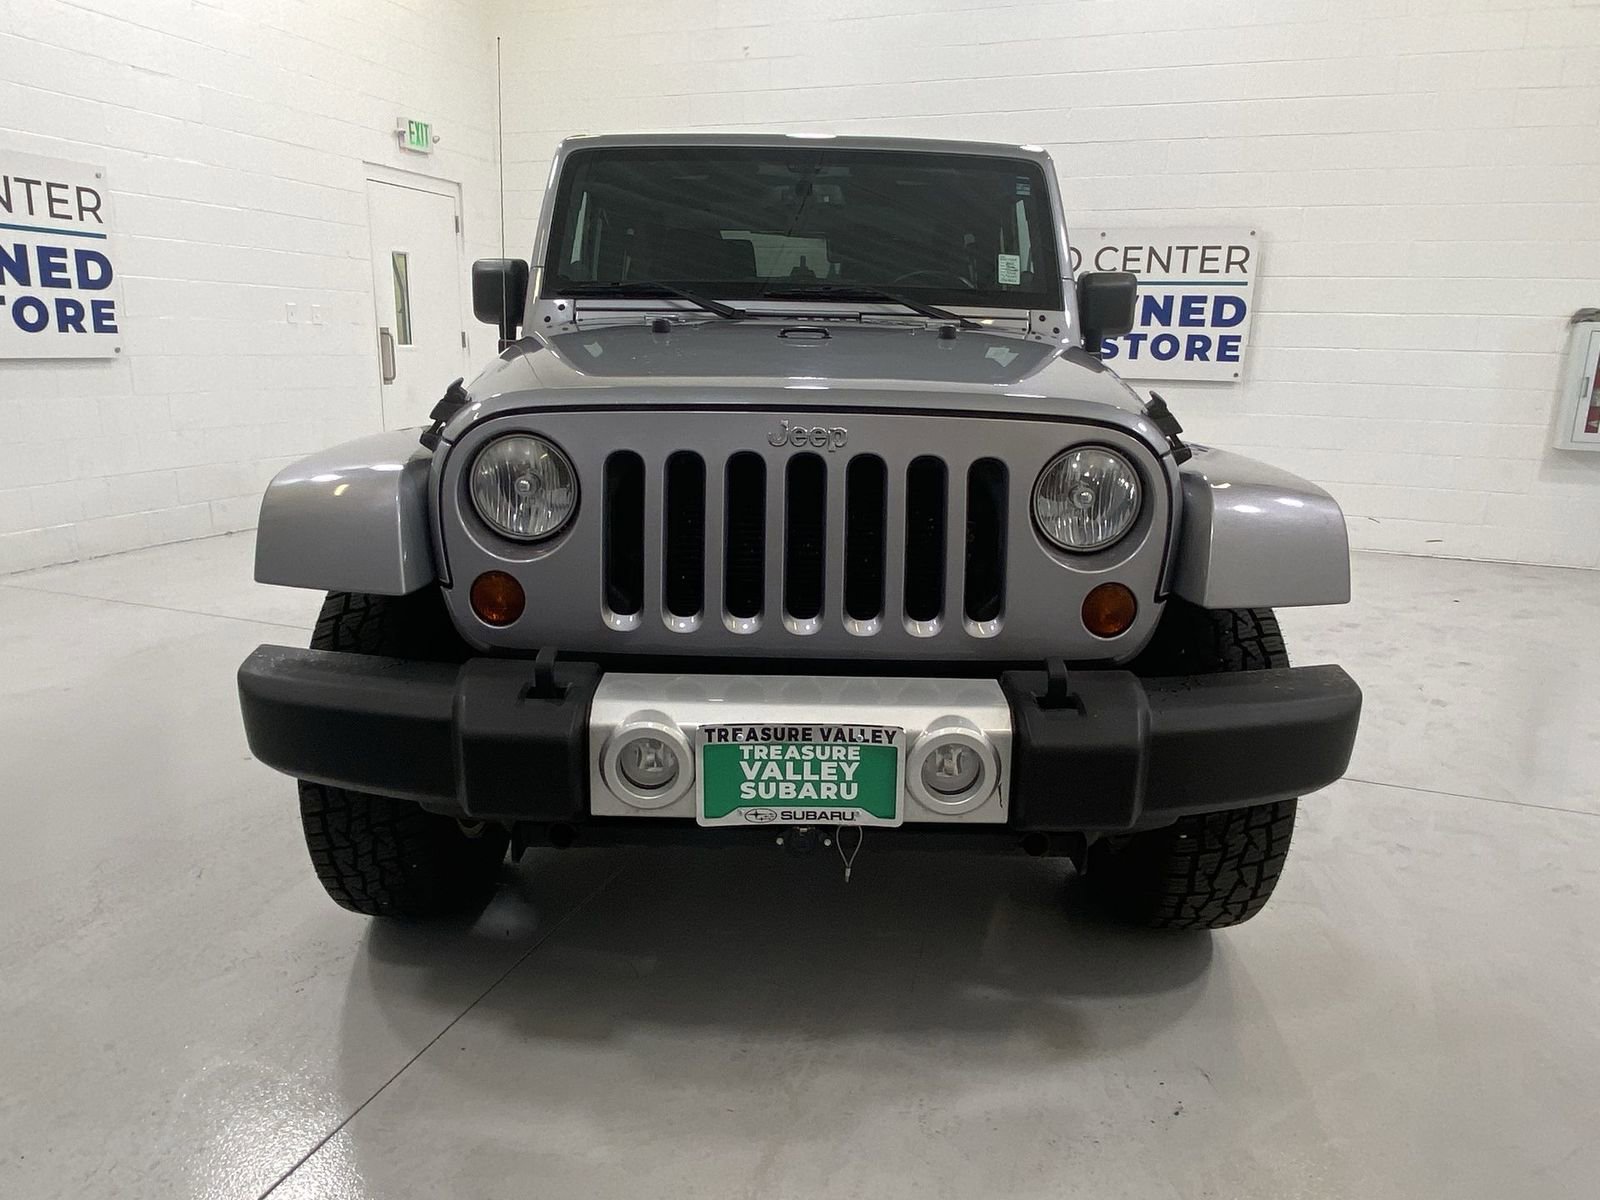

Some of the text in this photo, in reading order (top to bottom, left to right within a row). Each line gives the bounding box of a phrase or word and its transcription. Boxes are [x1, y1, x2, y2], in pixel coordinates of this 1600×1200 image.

[408, 120, 429, 148] EXIT
[1094, 245, 1251, 274] CENTER
[0, 294, 119, 334] ORE
[1135, 295, 1248, 328] NED
[1101, 333, 1242, 362] STORE
[767, 419, 848, 453] Jeep
[704, 727, 897, 744] TREASURE VALLEY
[739, 745, 861, 761] TREASURE
[739, 761, 861, 781] VALLEY
[739, 782, 858, 800] SUBARU
[780, 810, 856, 821] SUBARU
